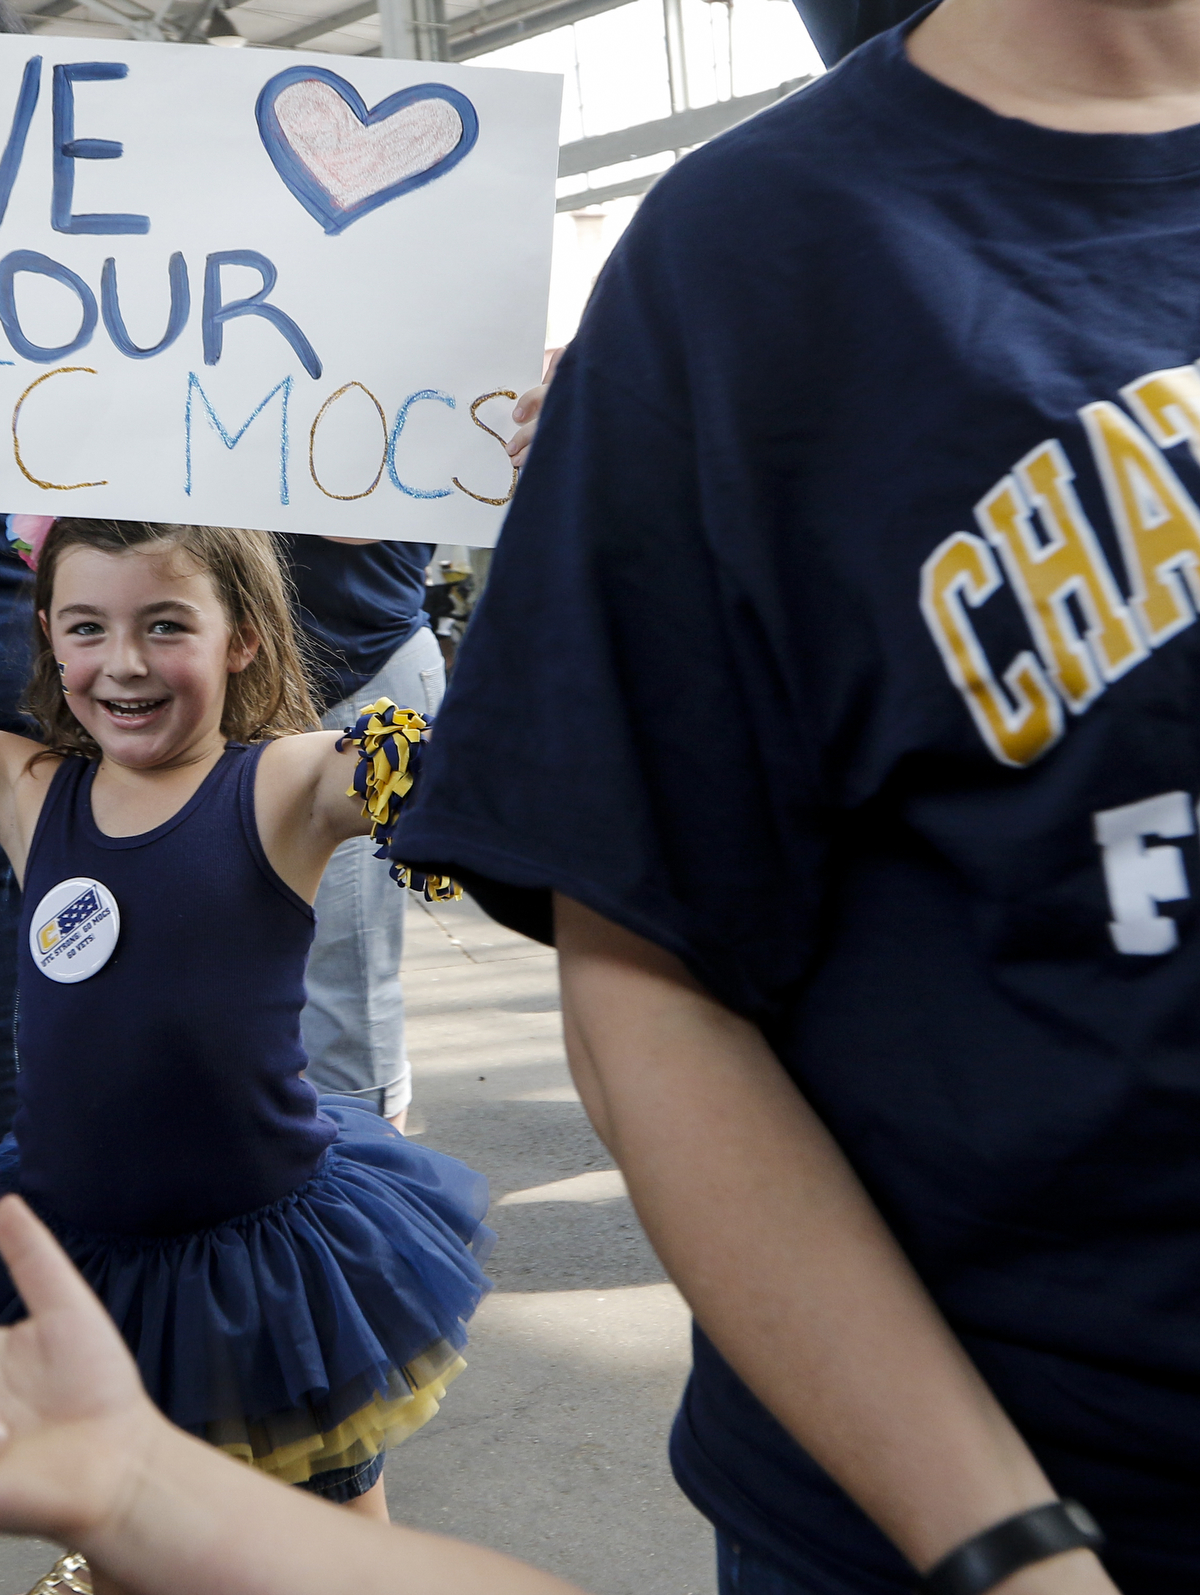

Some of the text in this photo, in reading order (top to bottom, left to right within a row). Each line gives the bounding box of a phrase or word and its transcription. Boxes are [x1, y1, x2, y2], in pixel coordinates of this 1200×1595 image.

[184, 372, 518, 507] MOCS
[82, 922, 93, 933] GO
[91, 907, 111, 925] MOCS
[1093, 788, 1200, 957] F
